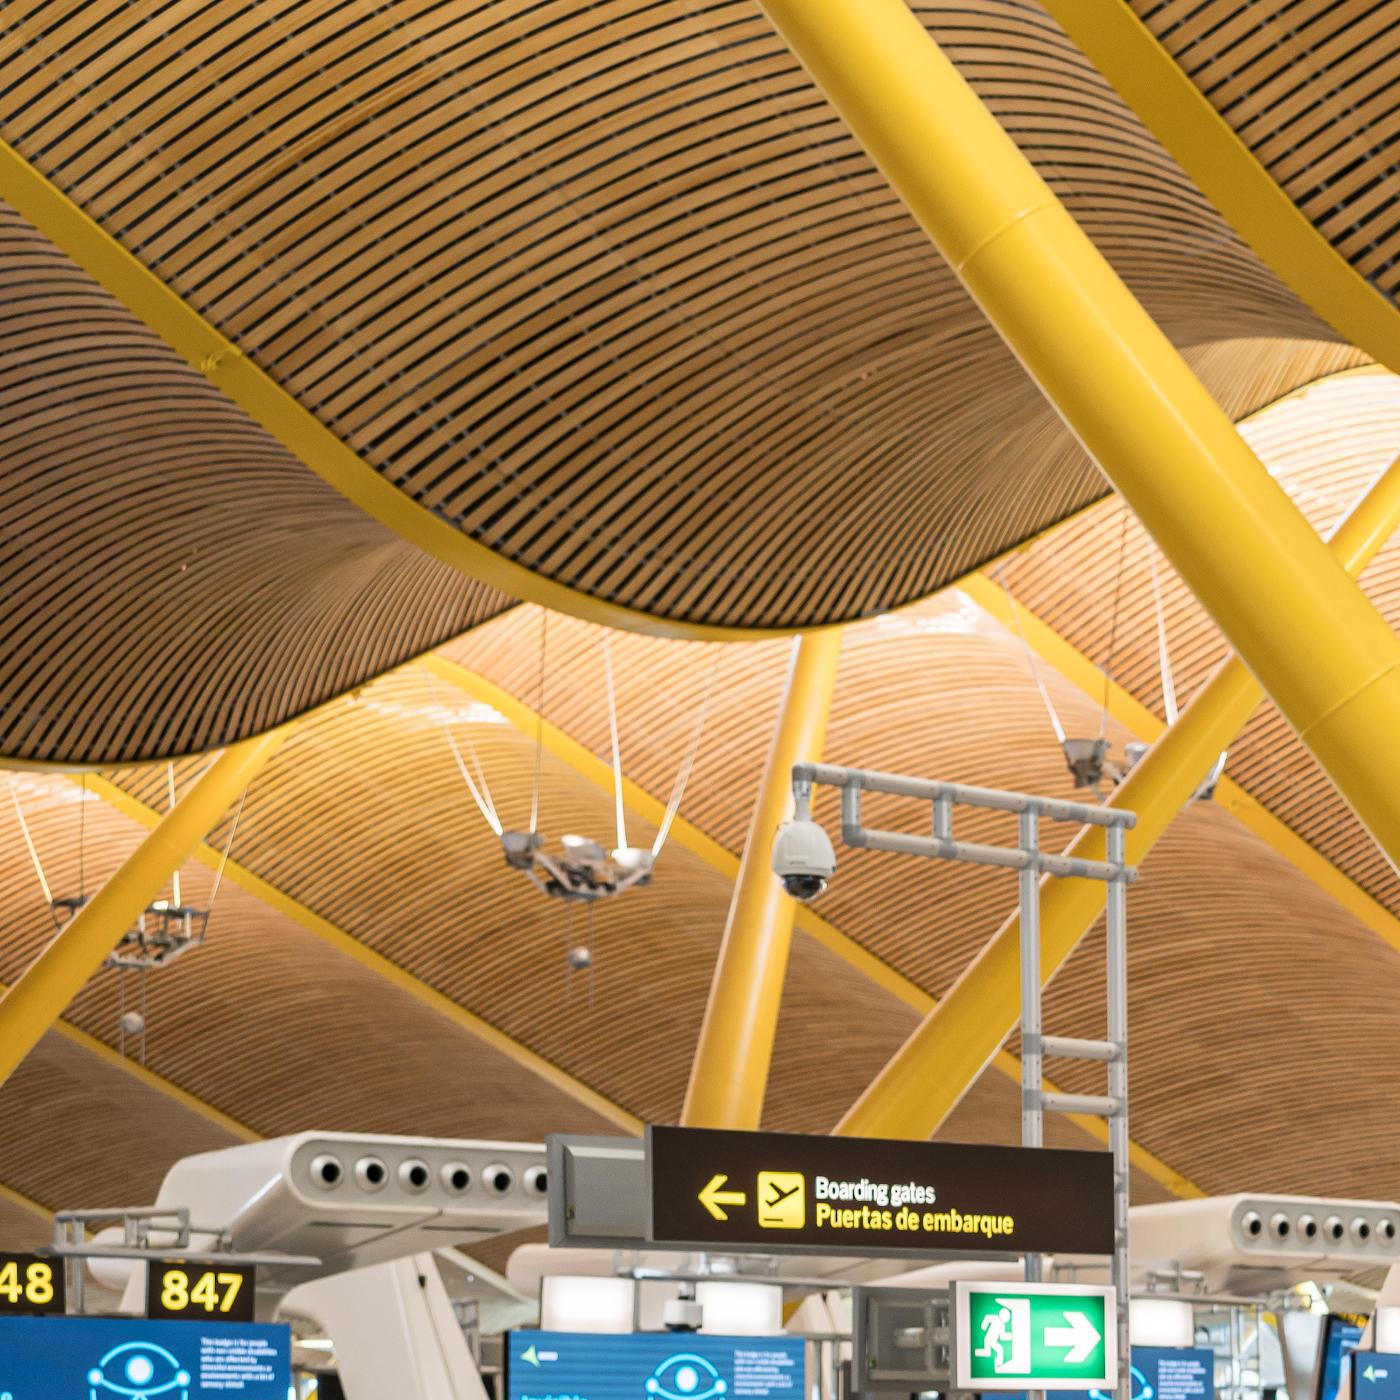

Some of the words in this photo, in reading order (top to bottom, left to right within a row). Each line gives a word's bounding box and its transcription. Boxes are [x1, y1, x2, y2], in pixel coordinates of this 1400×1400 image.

[815, 1176, 889, 1207] Boarding
[890, 1181, 936, 1207] gates
[816, 1203, 893, 1231] Puertas
[895, 1206, 920, 1232] de
[923, 1208, 1014, 1239] embarque
[161, 1269, 244, 1313] 847
